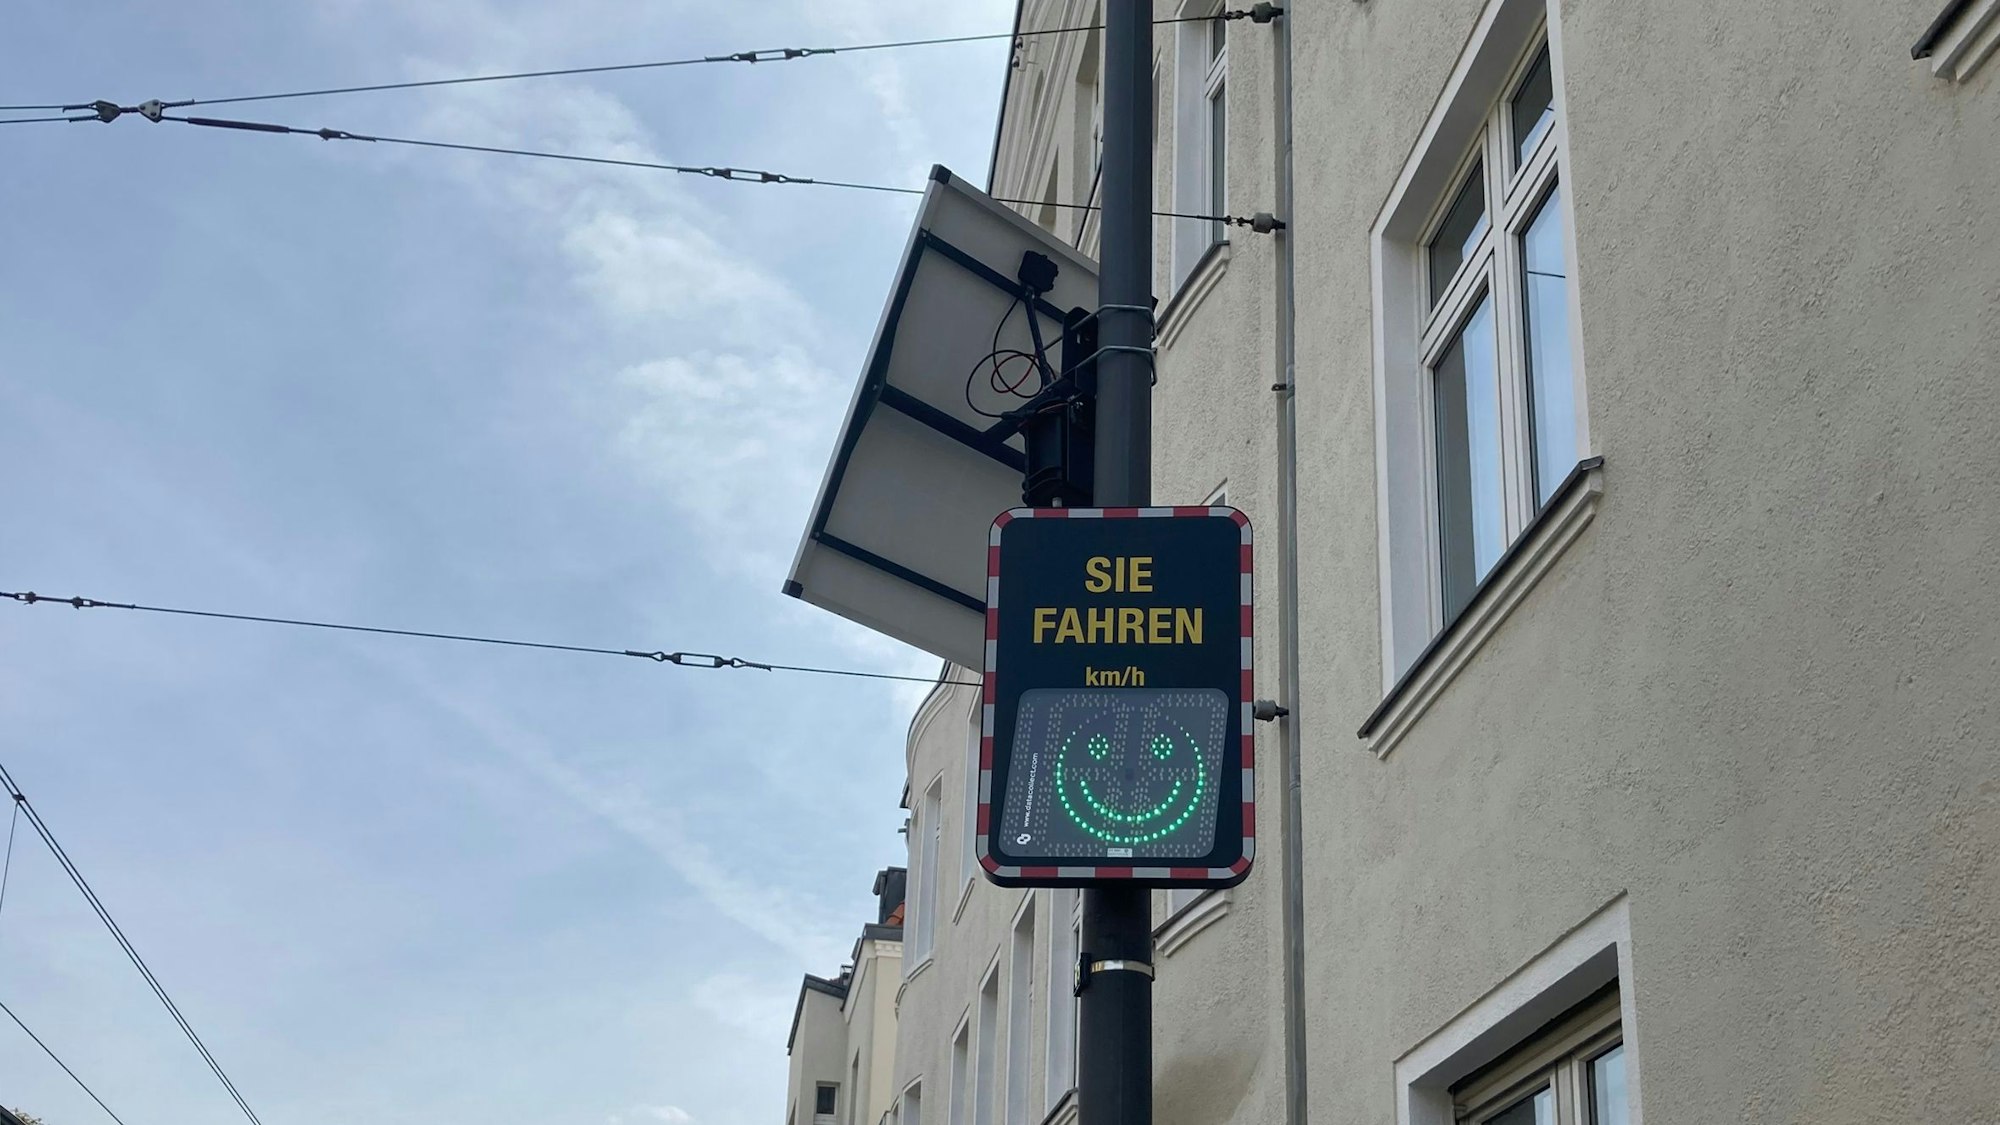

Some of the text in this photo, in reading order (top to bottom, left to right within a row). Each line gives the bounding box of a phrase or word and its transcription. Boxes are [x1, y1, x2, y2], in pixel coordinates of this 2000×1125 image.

[1085, 556, 1153, 593] SIE
[1033, 607, 1203, 644] FAHREN
[1085, 666, 1146, 687] km/h
[1023, 752, 1039, 828] www.datacollect.com
